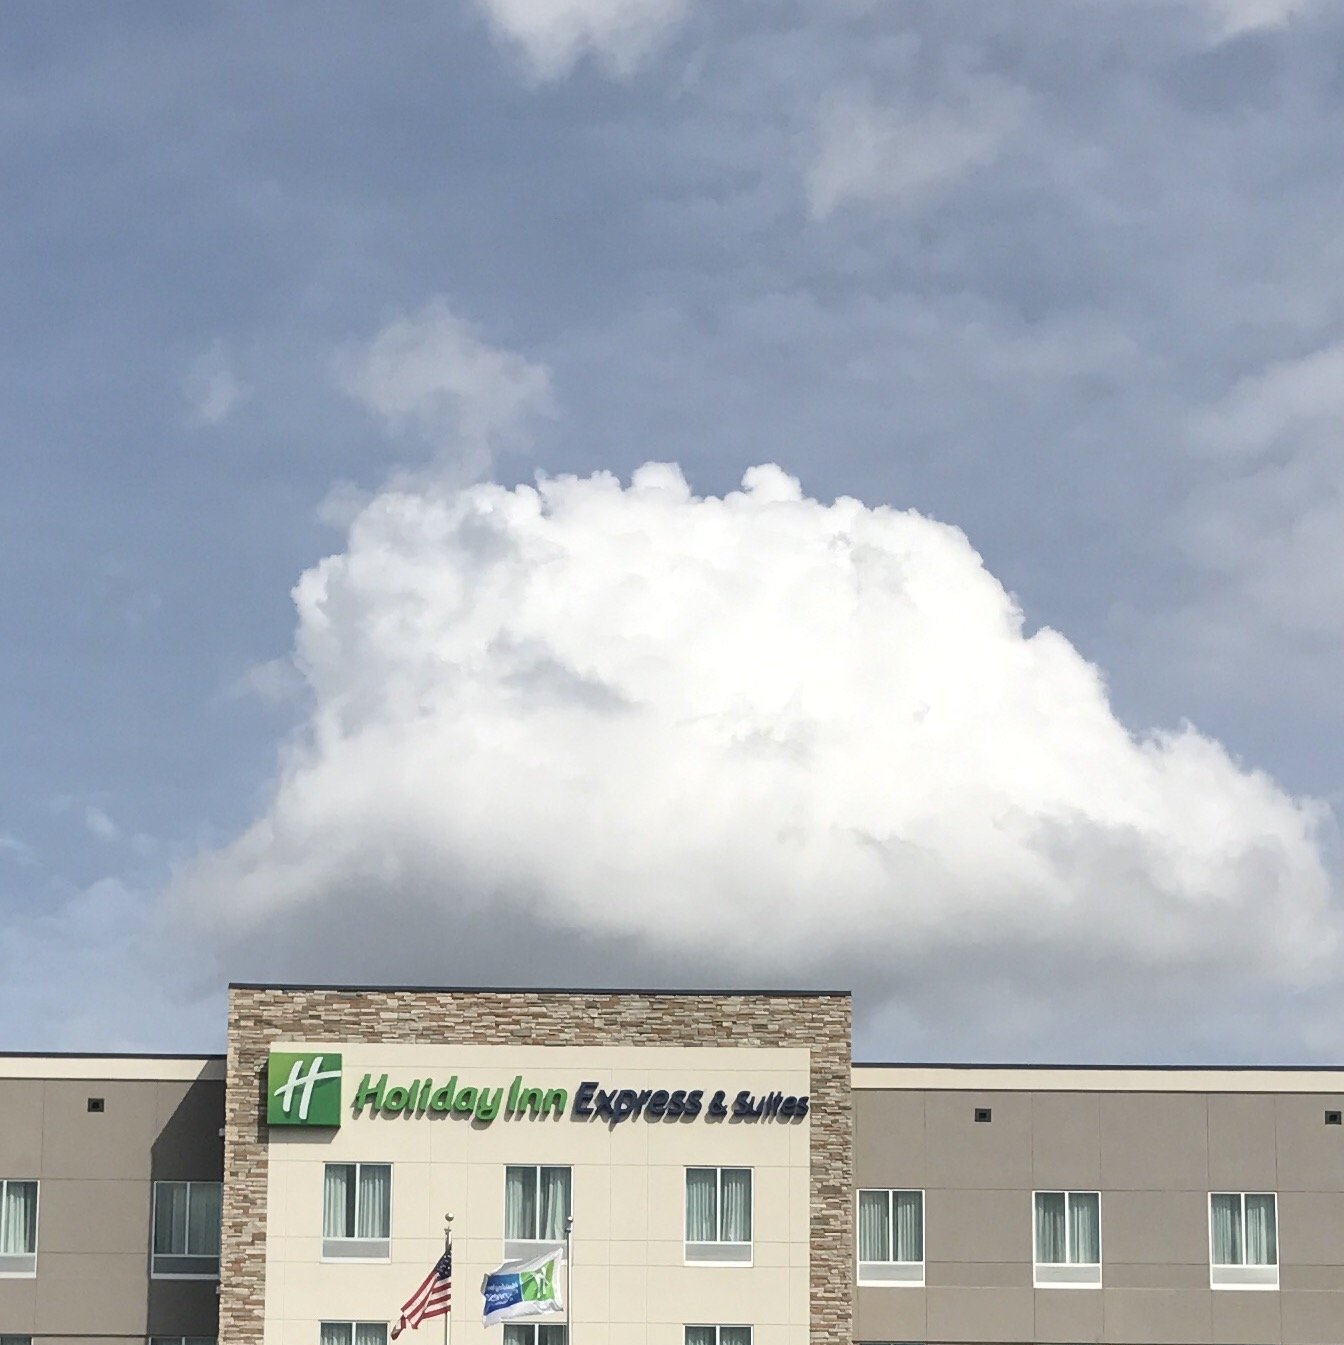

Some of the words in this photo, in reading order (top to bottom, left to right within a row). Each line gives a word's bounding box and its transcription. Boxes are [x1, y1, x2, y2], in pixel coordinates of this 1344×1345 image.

[356, 1073, 503, 1121] Holiday
[508, 1075, 568, 1115] Inn
[573, 1081, 704, 1128] Express
[708, 1090, 727, 1117] &
[732, 1090, 810, 1118] Suites
